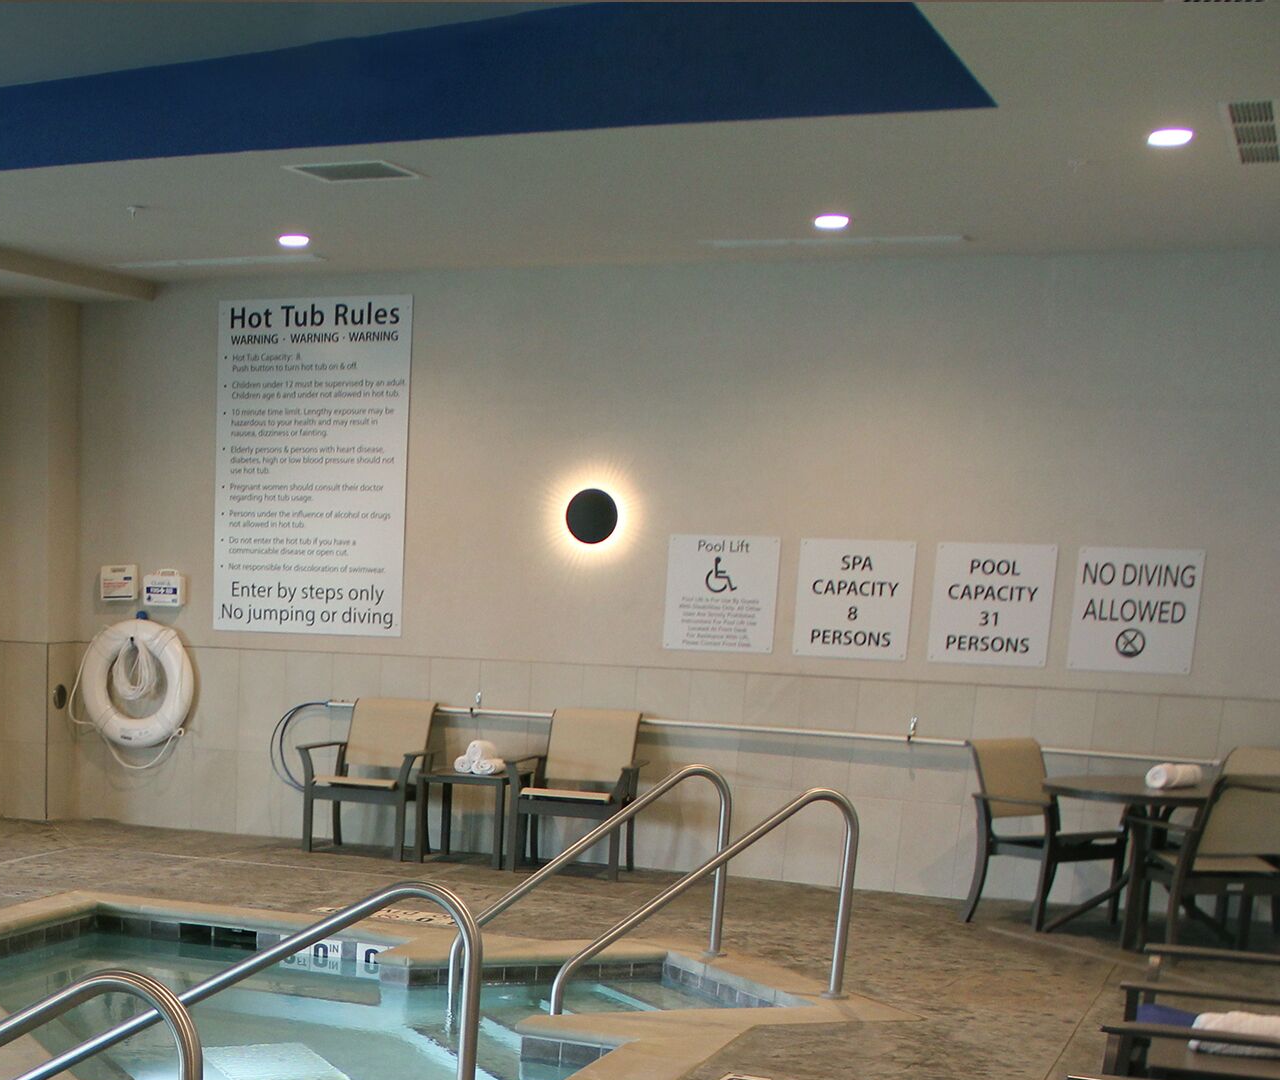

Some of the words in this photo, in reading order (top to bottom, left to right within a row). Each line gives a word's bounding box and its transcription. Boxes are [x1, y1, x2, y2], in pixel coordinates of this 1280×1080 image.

[231, 307, 272, 329] Hot
[281, 303, 325, 327] Tub
[335, 301, 400, 326] Rules
[231, 333, 279, 345] WARNING
[290, 332, 339, 343] WARNING
[349, 330, 399, 342] WARNING
[697, 539, 725, 553] Pool
[729, 539, 751, 553] Lift
[841, 555, 873, 571] SPA
[969, 558, 1021, 576] POOL
[1082, 562, 1116, 586] NO
[1122, 563, 1197, 589] DIVING
[231, 581, 273, 598] Enter
[277, 581, 297, 603] by
[301, 585, 344, 604] steps
[348, 584, 385, 606] only
[812, 579, 900, 597] CAPACITY
[948, 584, 1039, 602] CAPACITY
[221, 603, 244, 620] No
[246, 604, 315, 626] jumping
[320, 610, 338, 622] or
[341, 606, 393, 630] diving
[847, 606, 858, 621] 8
[979, 610, 999, 627] 31
[1081, 598, 1187, 624] ALLOWED
[810, 629, 892, 648] PERSONS
[945, 634, 1031, 653] PERSONS
[329, 944, 340, 954] IN
